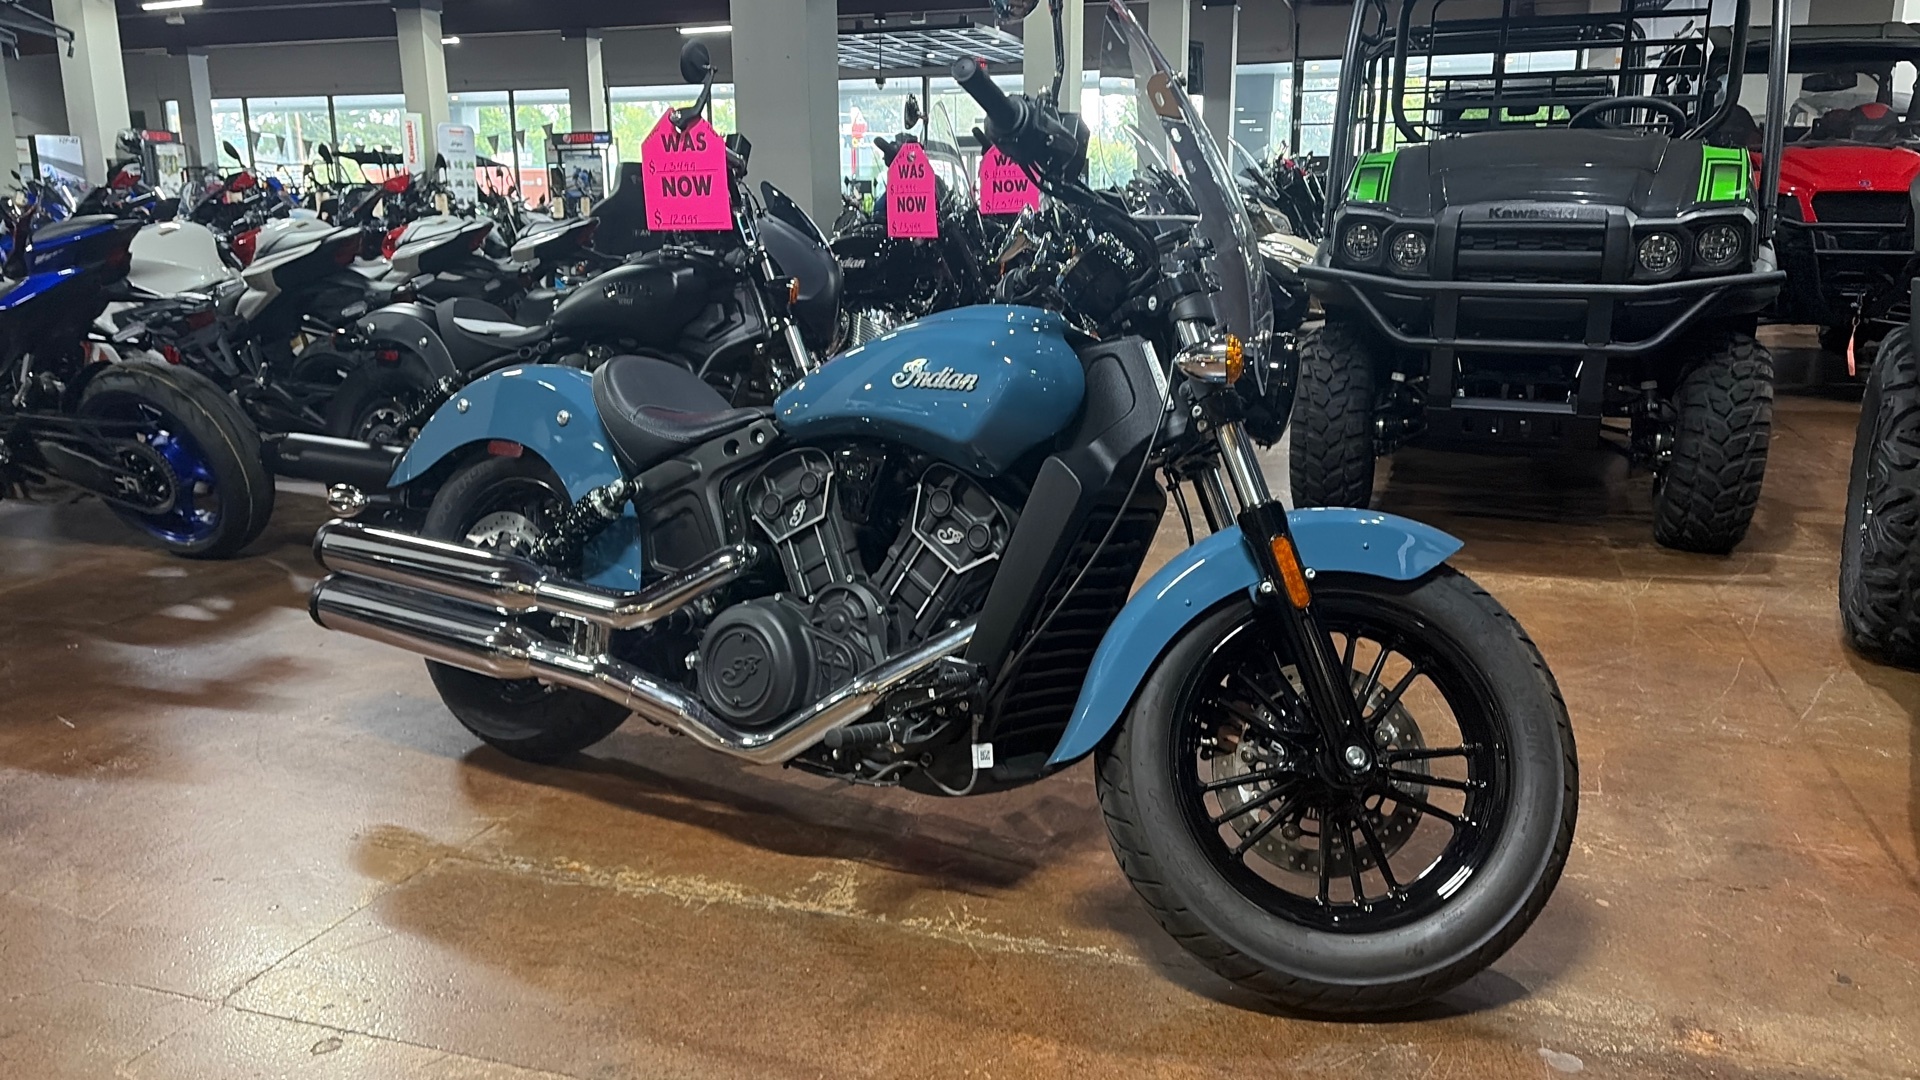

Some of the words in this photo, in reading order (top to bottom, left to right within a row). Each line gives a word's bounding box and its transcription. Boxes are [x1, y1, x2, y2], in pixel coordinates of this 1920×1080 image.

[661, 132, 707, 153] WAS
[898, 163, 925, 179] WAS
[661, 175, 712, 197] NOW
[993, 180, 1028, 193] NOW
[897, 196, 926, 213] NOW
[1489, 207, 1579, 219] Kawasaki
[891, 358, 979, 392] Indian
